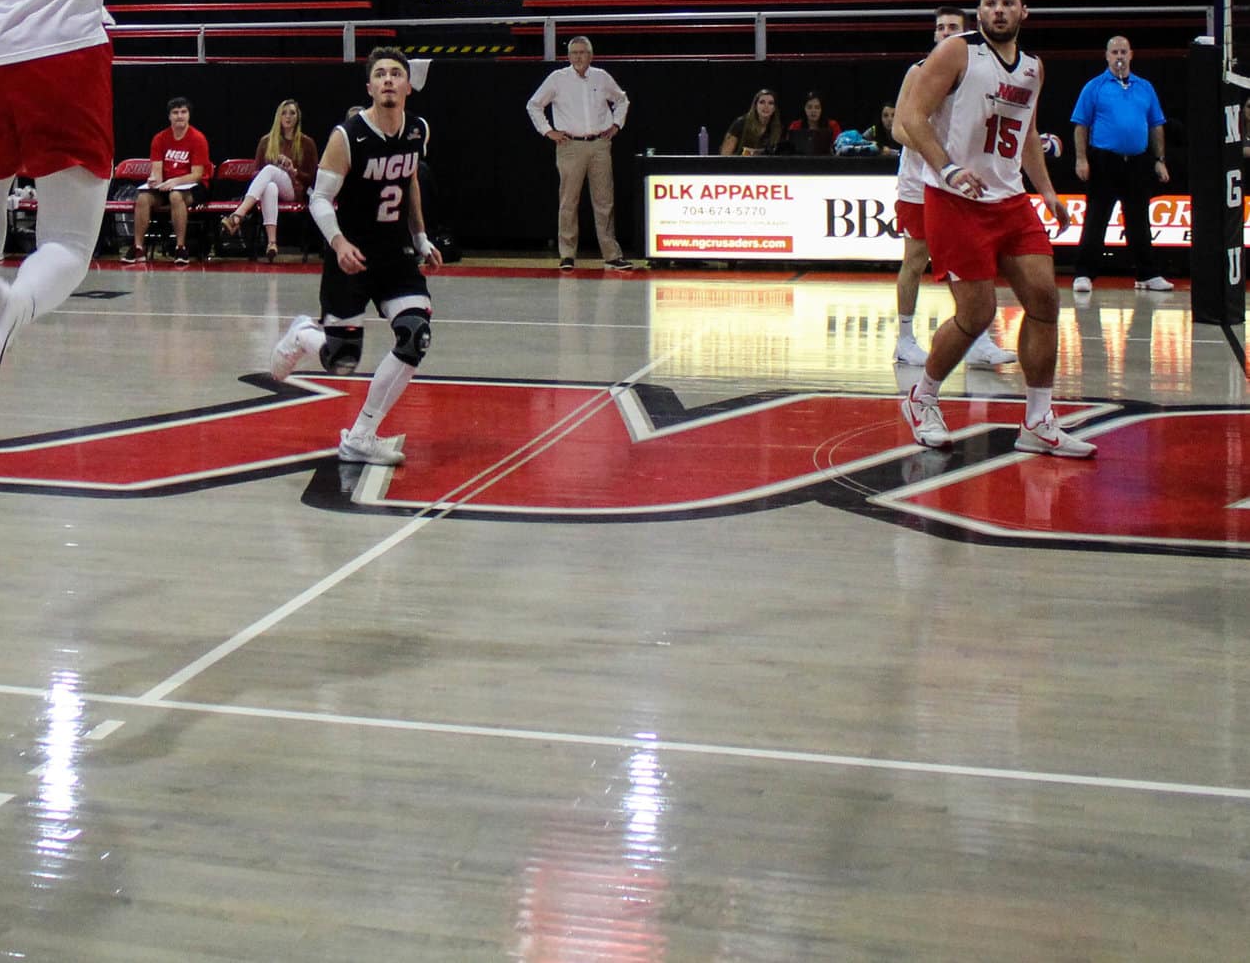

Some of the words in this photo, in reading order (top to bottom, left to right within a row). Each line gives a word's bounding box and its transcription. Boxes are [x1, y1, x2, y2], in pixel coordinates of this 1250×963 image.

[983, 114, 1022, 159] 15
[164, 149, 190, 160] NGU
[362, 152, 419, 181] NGU
[654, 184, 693, 200] DLK
[700, 185, 794, 200] APPAREL
[377, 185, 403, 222] 2
[682, 206, 767, 216] 704-674-5770
[662, 237, 786, 250] www.ngcrusaders.com
